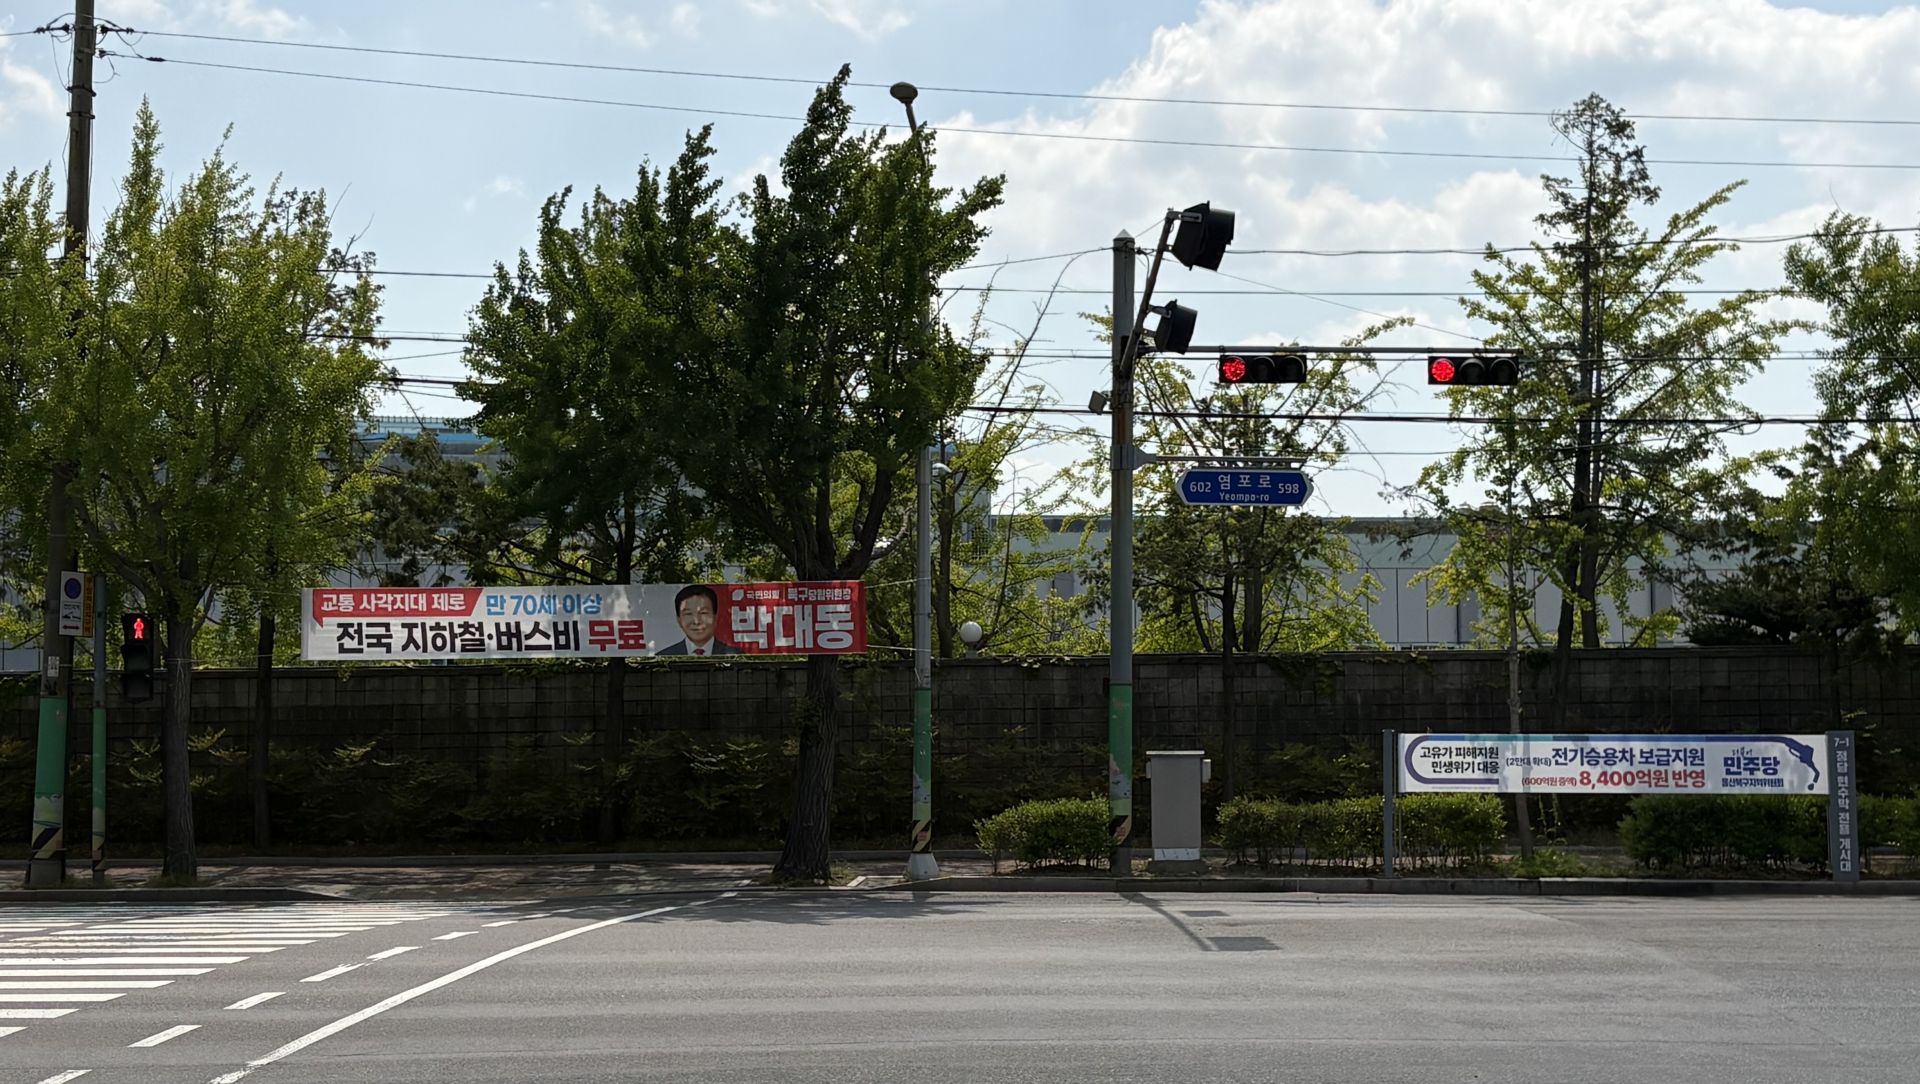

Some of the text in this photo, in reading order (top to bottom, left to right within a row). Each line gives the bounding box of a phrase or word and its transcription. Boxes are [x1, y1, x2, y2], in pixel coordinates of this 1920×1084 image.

[1190, 482, 1211, 493] 602
[1218, 474, 1271, 490] 염포로
[1278, 483, 1299, 494] 598
[1219, 492, 1270, 502] Yeompo-ro
[321, 592, 466, 612] 교통 사각지대 제로
[486, 593, 603, 616] 만 70세 이상
[336, 622, 393, 654] 전국
[589, 619, 646, 652] 무료
[731, 604, 854, 649] 박대동
[1420, 746, 1499, 759] 고유가 피해지원
[1834, 737, 1850, 748] 7-1
[1431, 760, 1500, 774] 민생위기 대응
[1506, 757, 1531, 767] (2만대
[1552, 747, 1635, 767] 전기승용차
[1638, 747, 1705, 767] 보급지원
[1723, 756, 1780, 776] 민주당
[1836, 750, 1848, 774] 정당
[1579, 769, 1669, 790] 8,400억원
[1672, 769, 1705, 788] 반영
[1837, 776, 1849, 810] 현수막
[1839, 838, 1852, 872] 게시대
